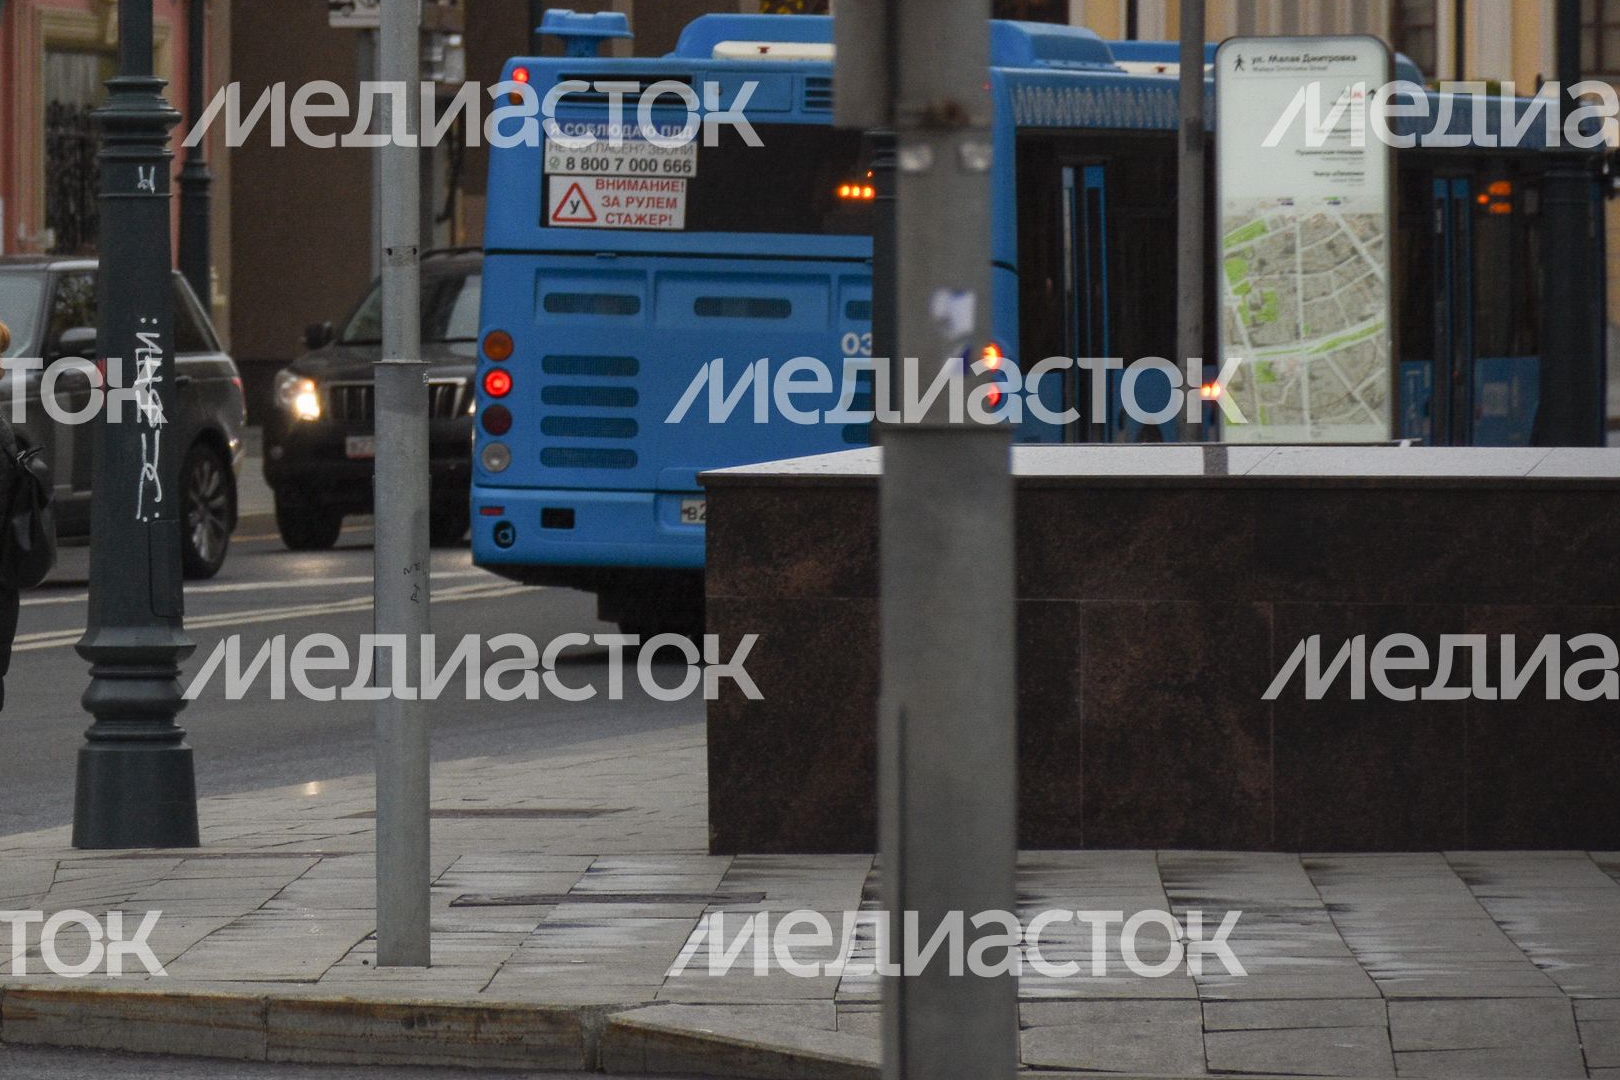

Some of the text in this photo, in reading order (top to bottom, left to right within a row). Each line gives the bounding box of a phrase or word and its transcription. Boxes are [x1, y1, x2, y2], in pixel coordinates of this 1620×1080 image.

[566, 156, 692, 173] 8 800 7 000 666
[595, 178, 685, 193] ВНИМАНИЕ!
[601, 195, 678, 209] ЗА РУЛЕМ
[605, 212, 673, 226] СТАЖЕР!
